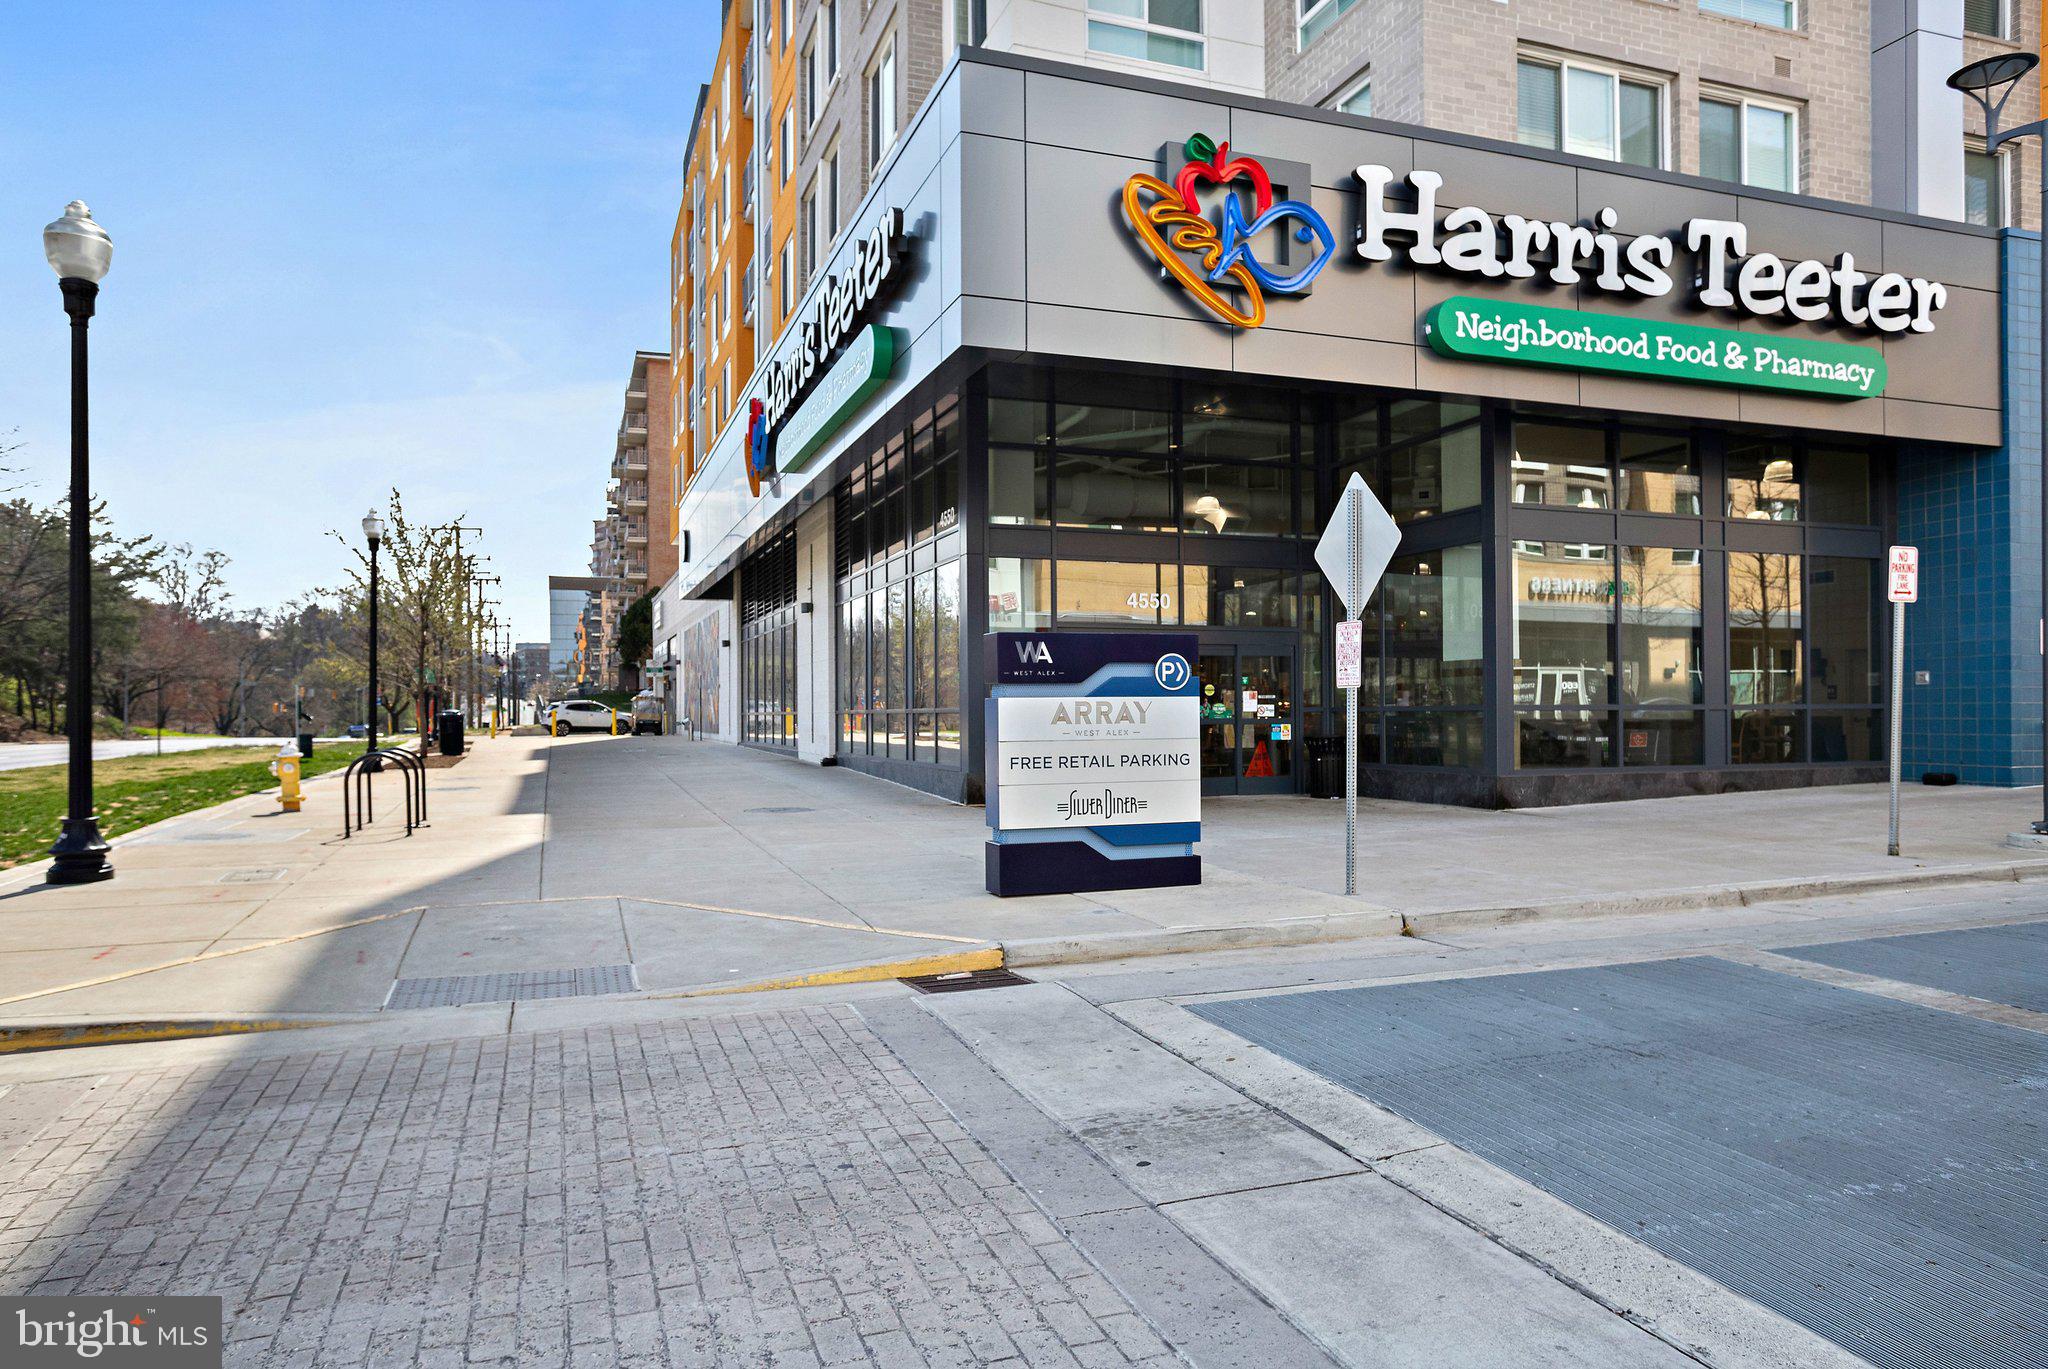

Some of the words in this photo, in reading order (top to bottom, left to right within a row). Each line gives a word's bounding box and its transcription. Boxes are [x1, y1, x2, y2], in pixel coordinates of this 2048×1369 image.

[1356, 164, 1673, 296] Harris
[1688, 218, 1947, 333] Teeter
[764, 322, 815, 434] Harris
[815, 207, 896, 363] Teeter
[1454, 310, 1650, 360] Neighborhood
[1656, 334, 1719, 368] Food
[1723, 341, 1749, 370] &
[1754, 347, 1875, 391] Pharmacy
[1898, 552, 1909, 562] NO
[1126, 592, 1171, 610] 4550
[1015, 641, 1054, 664] WA
[1051, 701, 1152, 725] ARRAY
[1075, 729, 1100, 737] WEST
[1010, 756, 1052, 770] FREE
[1058, 755, 1115, 769] RETAIL
[1120, 753, 1190, 767] PARKING
